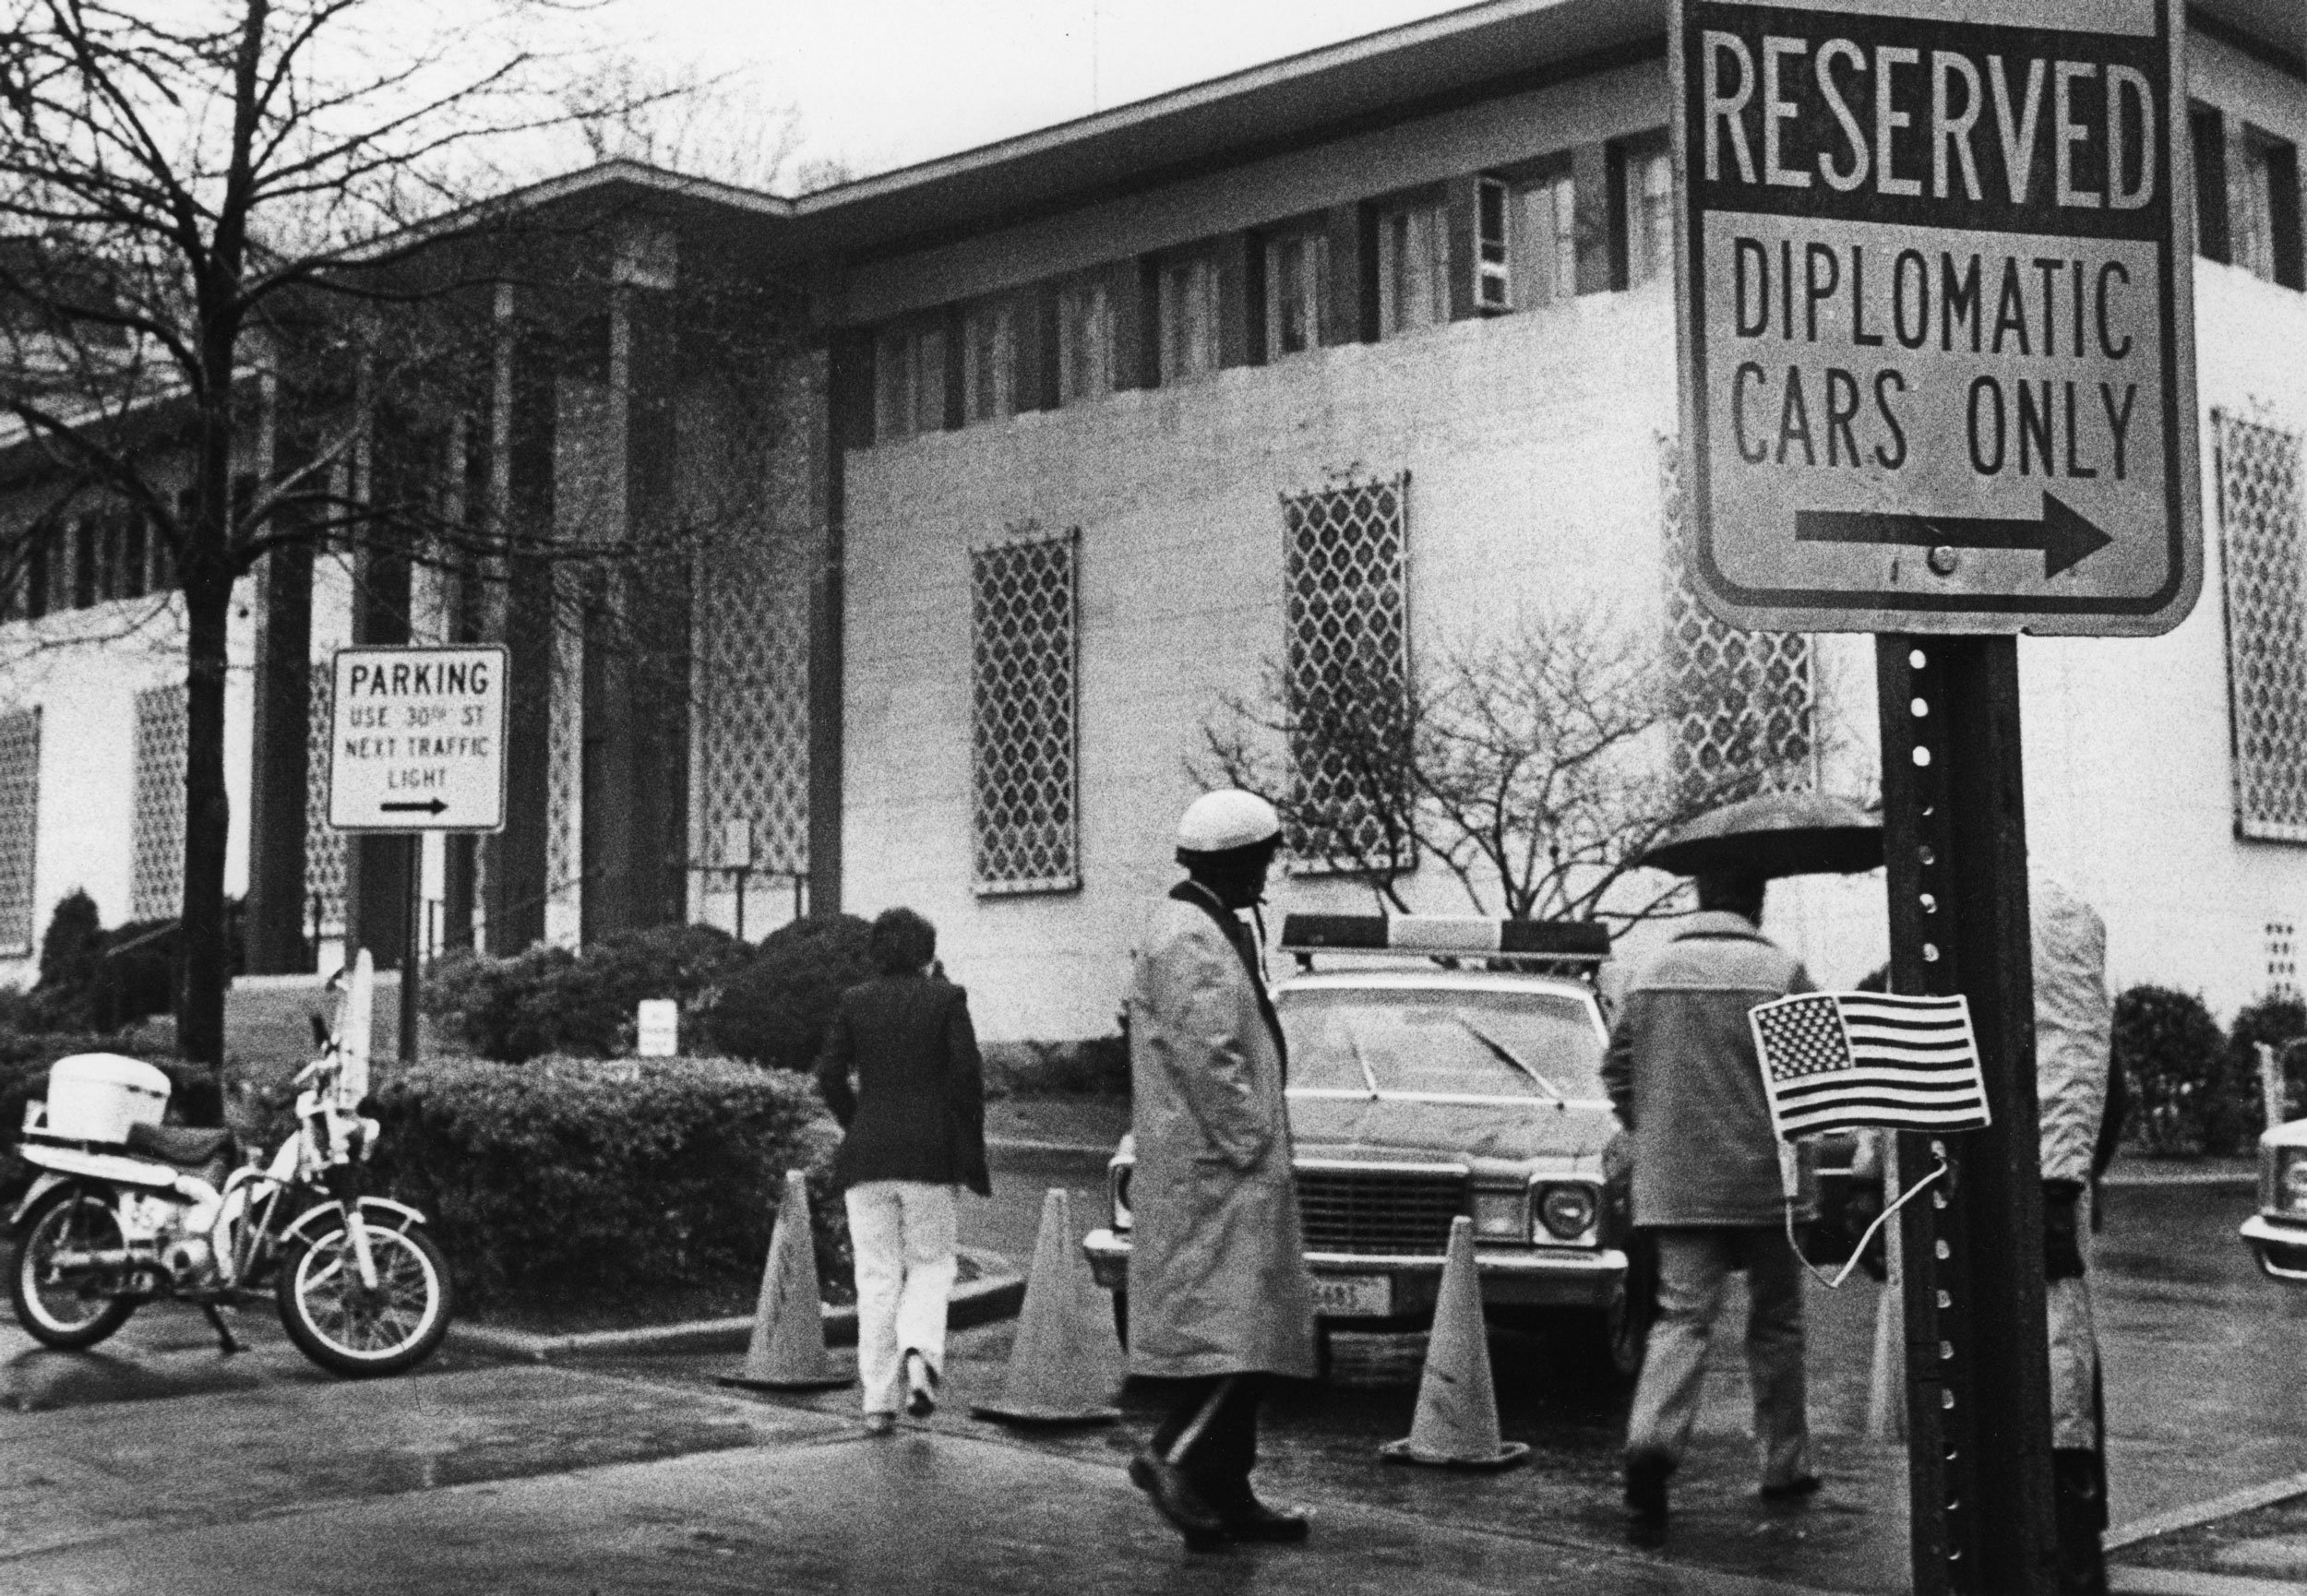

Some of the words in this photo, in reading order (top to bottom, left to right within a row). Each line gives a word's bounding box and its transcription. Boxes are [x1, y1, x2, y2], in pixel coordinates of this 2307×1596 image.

[1702, 30, 2156, 210] RESERVED
[1734, 236, 2133, 360] DIPLOMATIC
[1732, 361, 1908, 470] CARS
[1966, 375, 2138, 481] ONLY
[350, 661, 489, 696] PARKING
[350, 705, 388, 728] USE
[460, 704, 485, 727] ST
[345, 737, 397, 759] NEXT
[408, 736, 489, 758] TRAFFIC
[387, 767, 447, 790] LIGHT
